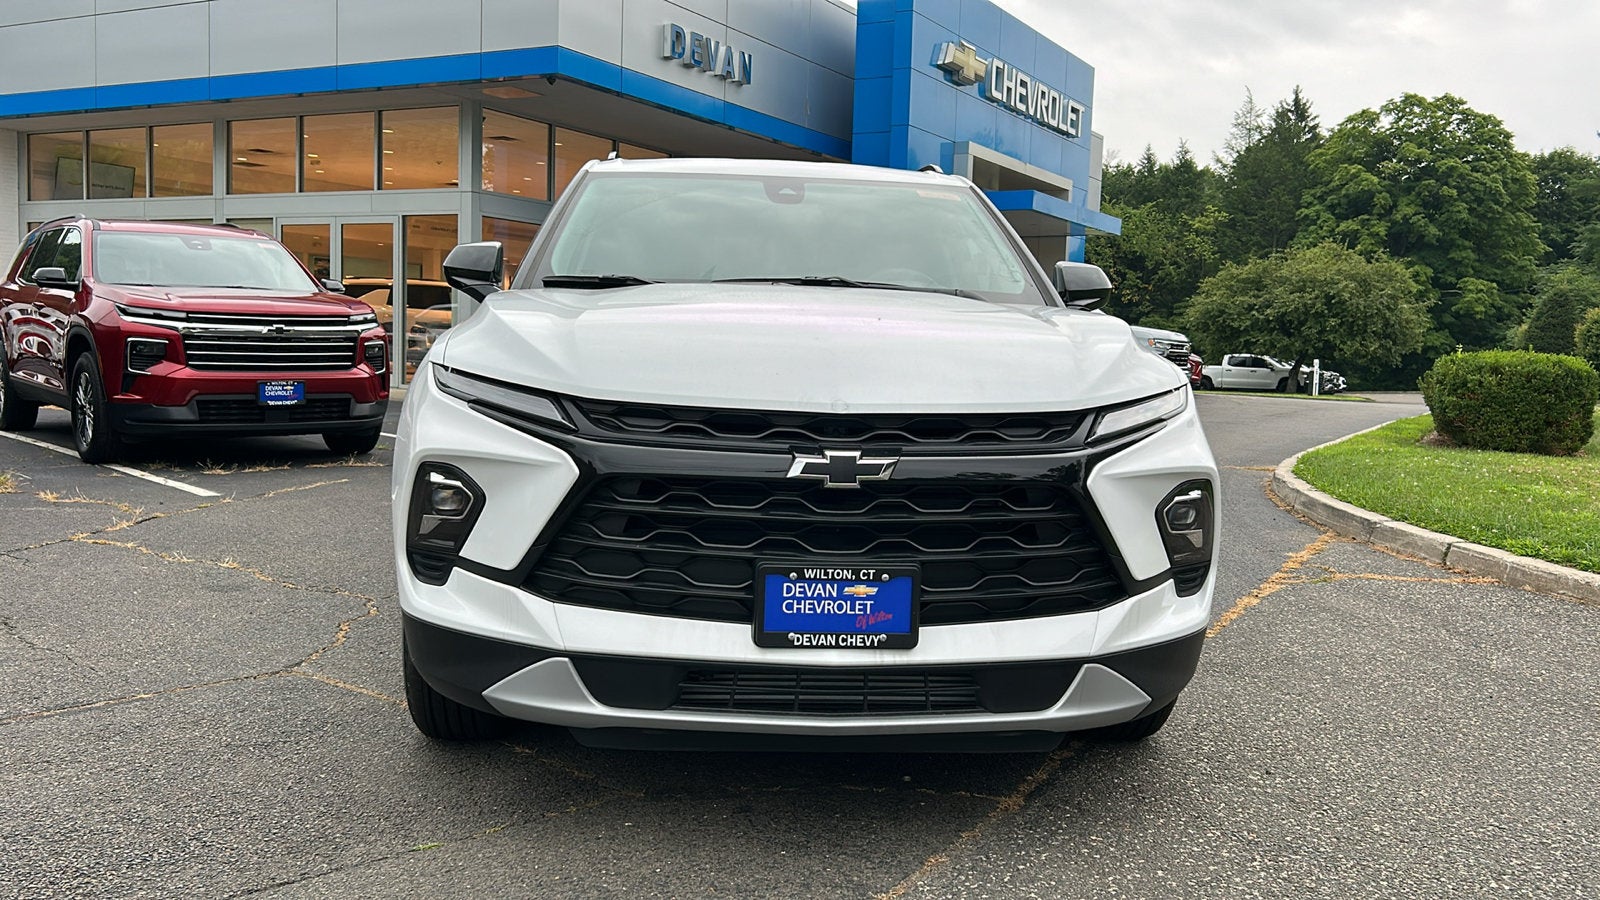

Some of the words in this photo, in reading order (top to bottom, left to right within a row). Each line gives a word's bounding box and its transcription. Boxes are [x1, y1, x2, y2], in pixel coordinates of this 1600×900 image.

[664, 23, 752, 85] DEVAN
[990, 58, 1085, 138] CHEVROLET
[804, 568, 855, 580] WILTON,
[859, 569, 876, 580] CT
[783, 583, 837, 598] DEVAN
[782, 600, 874, 614] CHEVROLET
[856, 615, 867, 630] Of
[868, 611, 893, 625] Wilton
[794, 634, 836, 646] DEVAN
[838, 635, 880, 646] CHEVY
